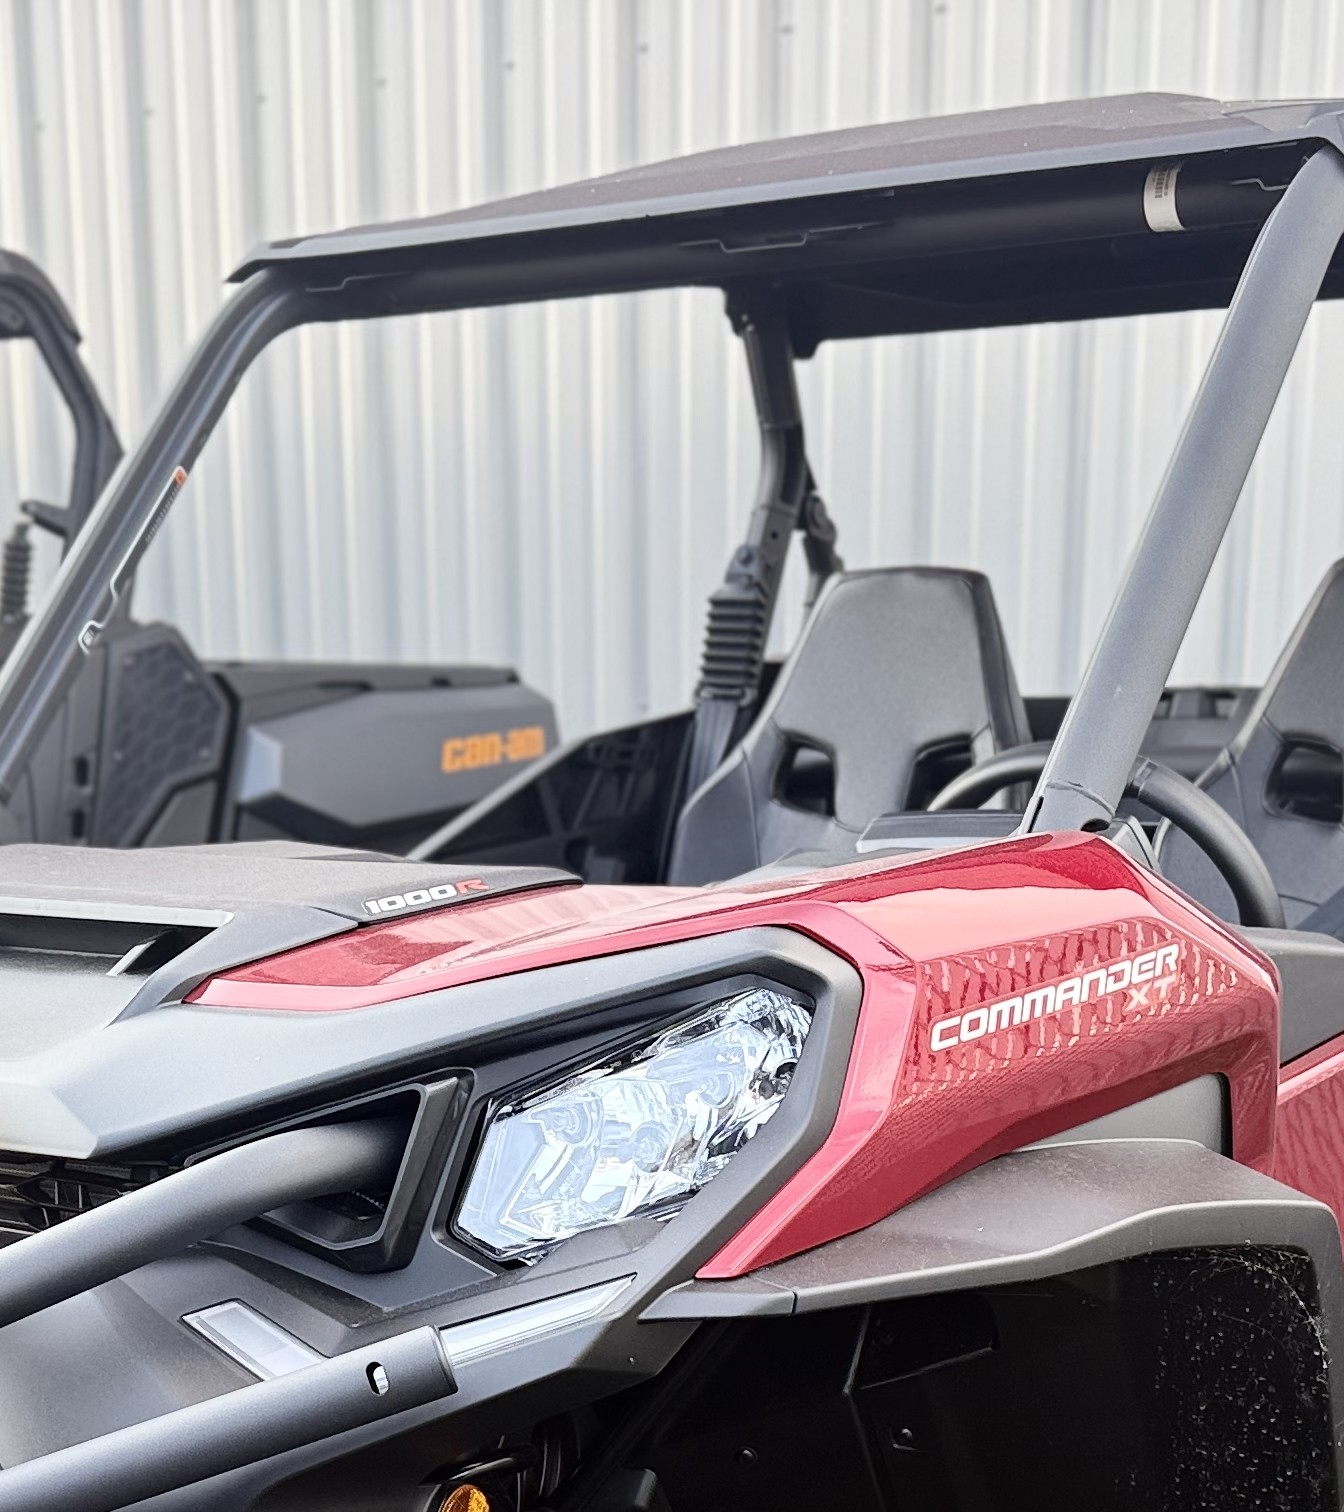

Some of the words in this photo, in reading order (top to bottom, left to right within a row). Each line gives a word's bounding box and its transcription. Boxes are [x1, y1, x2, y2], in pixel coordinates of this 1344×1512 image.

[364, 878, 490, 915] 1000R
[930, 943, 1181, 1052] COMMANDER
[1123, 974, 1178, 1015] XT
